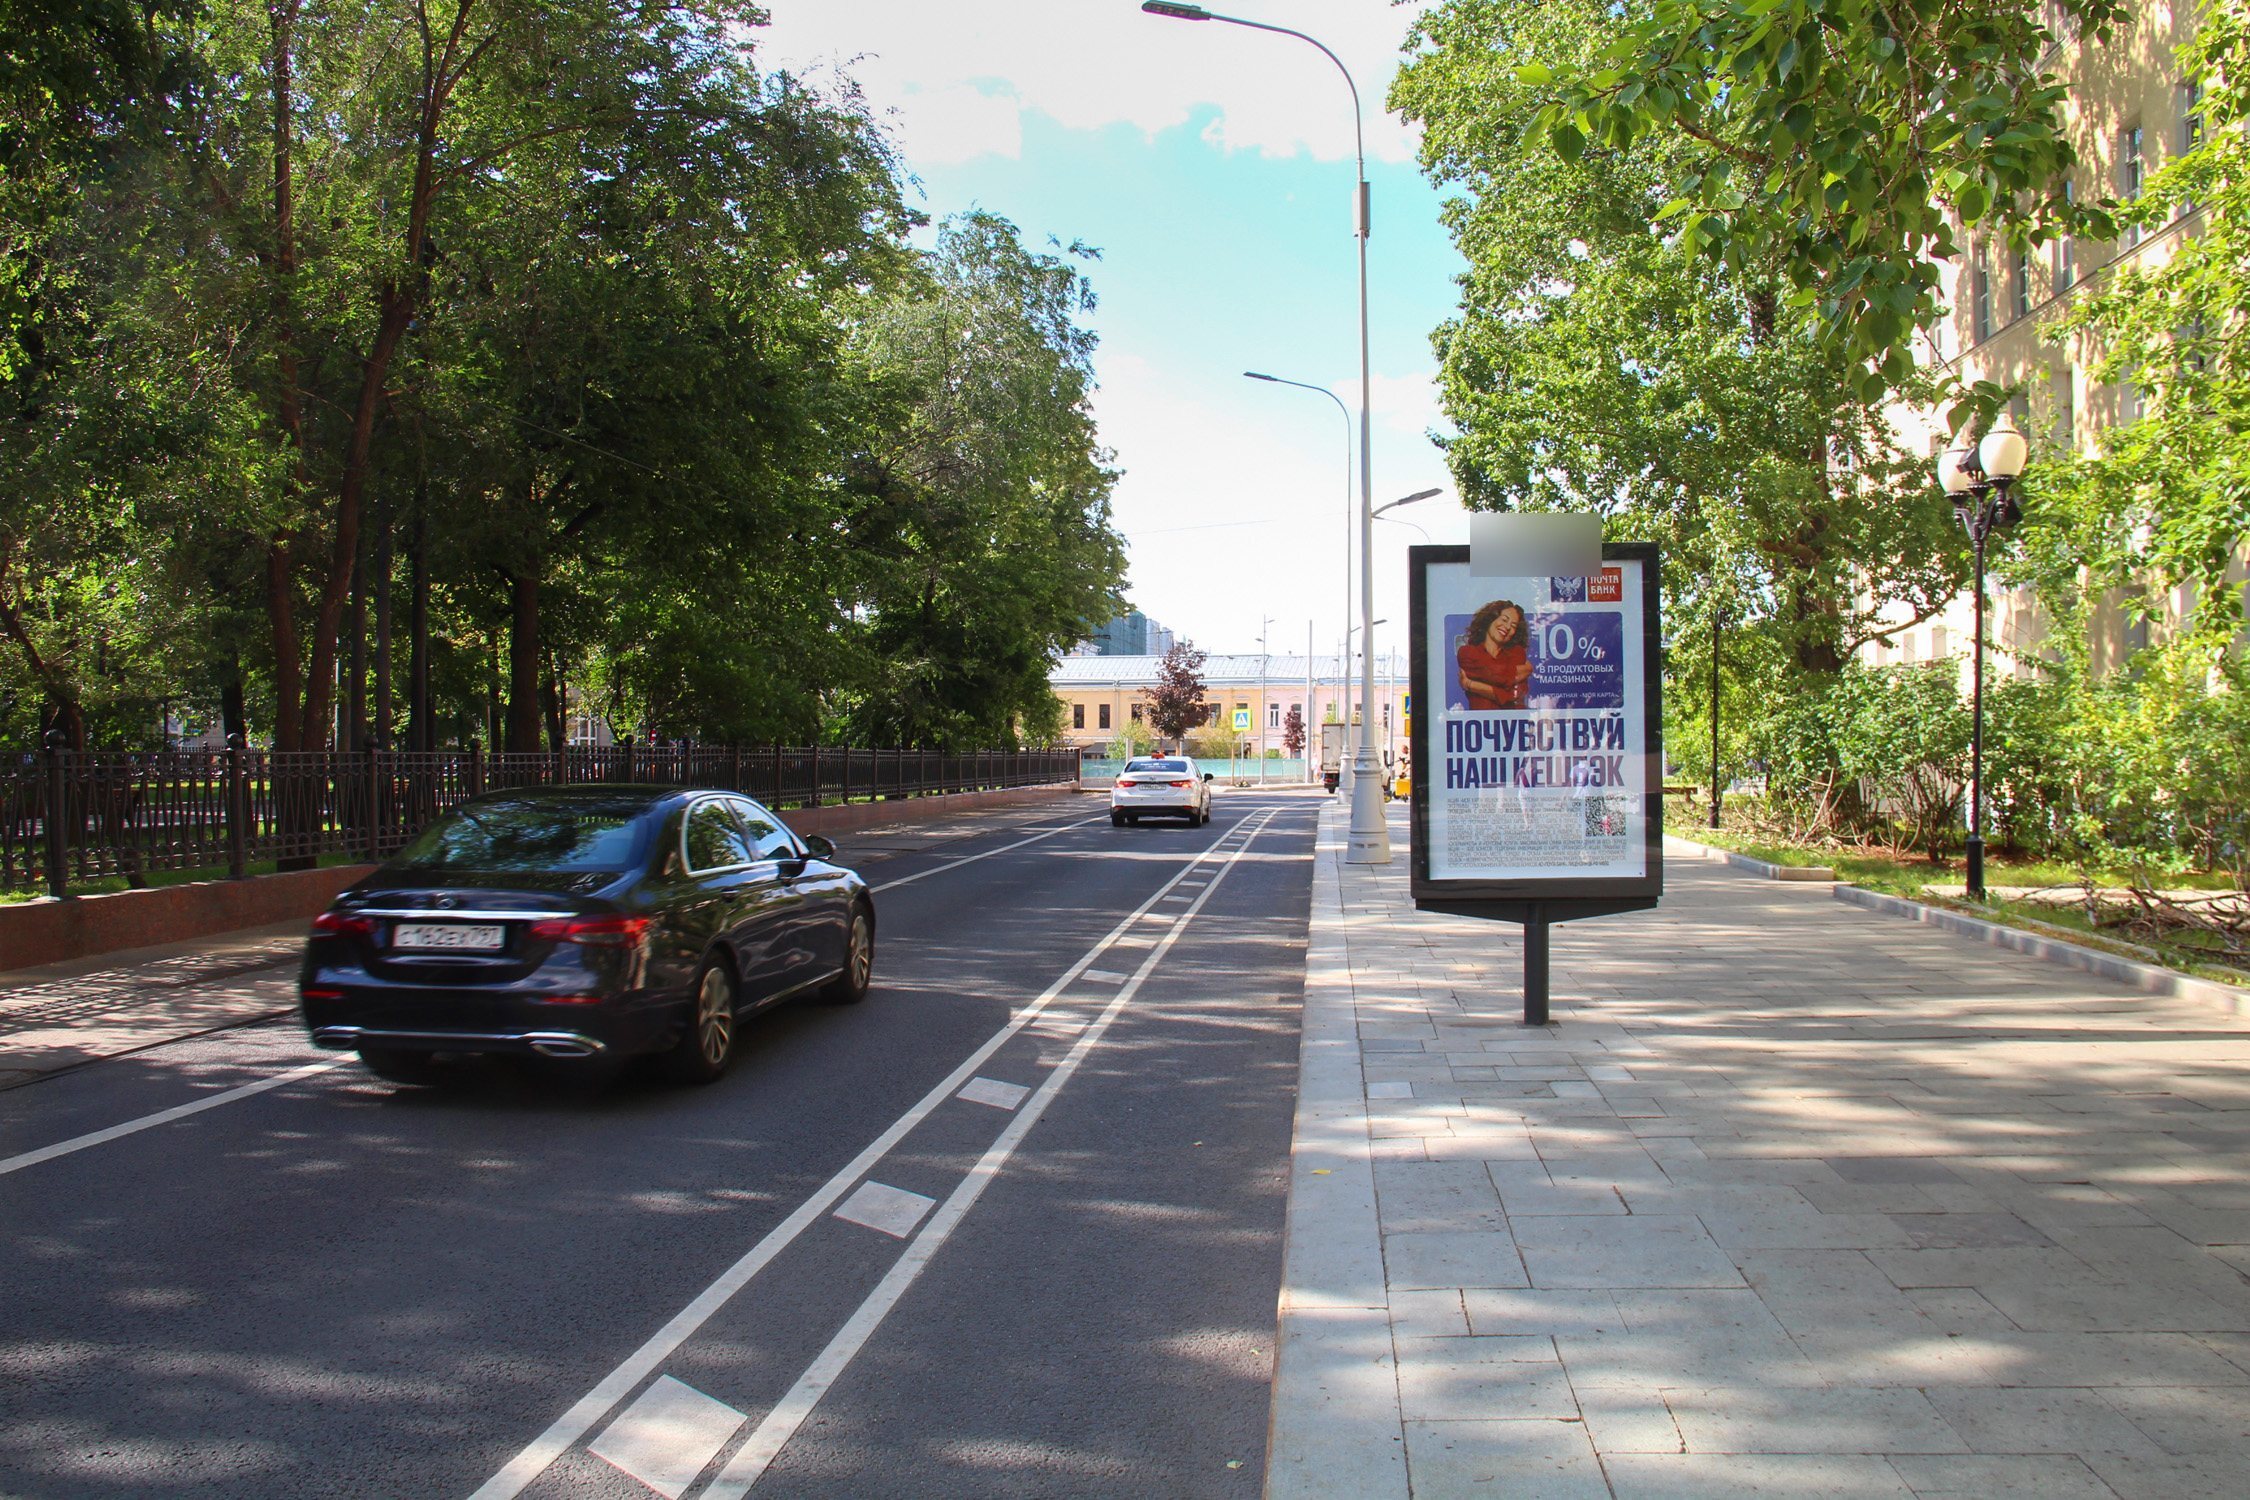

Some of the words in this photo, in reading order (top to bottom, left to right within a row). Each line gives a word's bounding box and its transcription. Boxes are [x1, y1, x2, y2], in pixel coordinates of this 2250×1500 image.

[1590, 574, 1619, 584] ПОЧТА
[1590, 585, 1616, 595] БАНК
[1539, 665, 1546, 674] В
[1547, 664, 1614, 674] ПРОДУКТОВЫХ
[1446, 712, 1625, 753] ПОЧУВСТВУЙ
[1446, 756, 1507, 789] НАШ
[1513, 755, 1625, 788] КЕШБЭК
